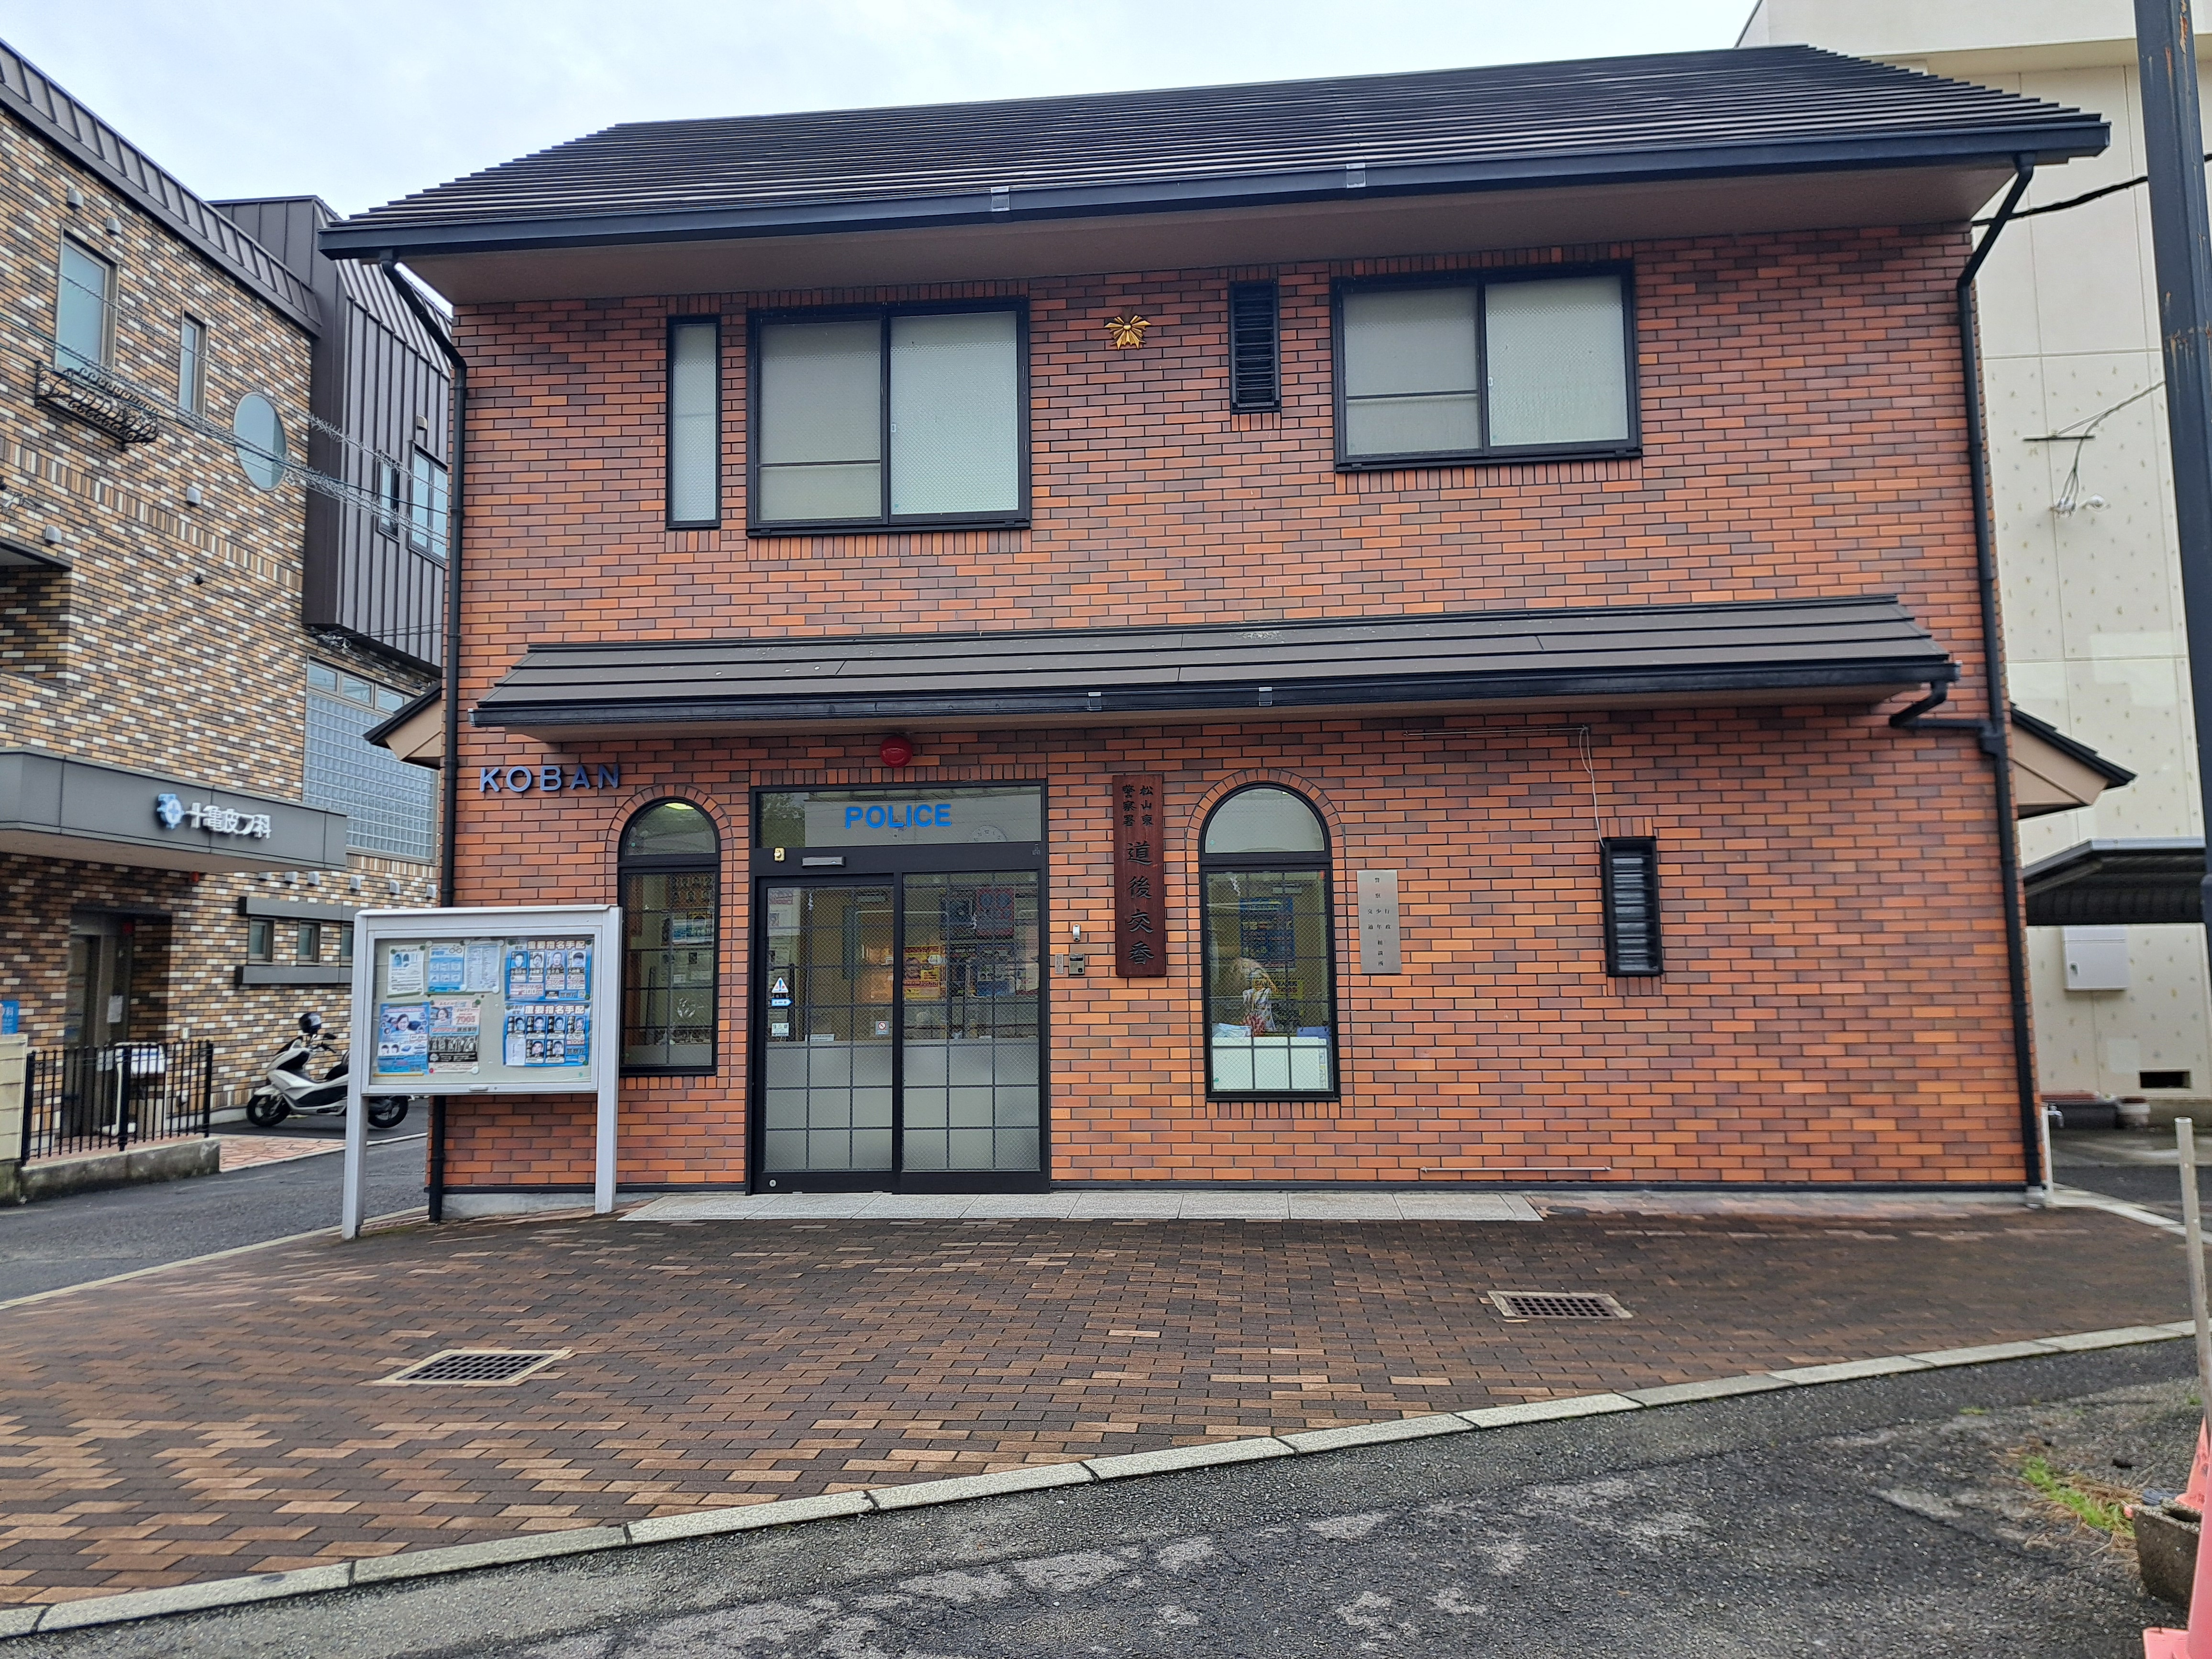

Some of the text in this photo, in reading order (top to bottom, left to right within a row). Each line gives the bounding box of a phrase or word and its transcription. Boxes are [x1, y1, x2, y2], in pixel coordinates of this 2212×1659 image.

[479, 763, 620, 793] KOBAN
[844, 804, 952, 829] POLICE
[1122, 784, 1137, 828] 警察署
[1127, 841, 1154, 965] 道後交番
[527, 940, 586, 950] 重要指名手配
[524, 1005, 586, 1015] 重要指名手配
